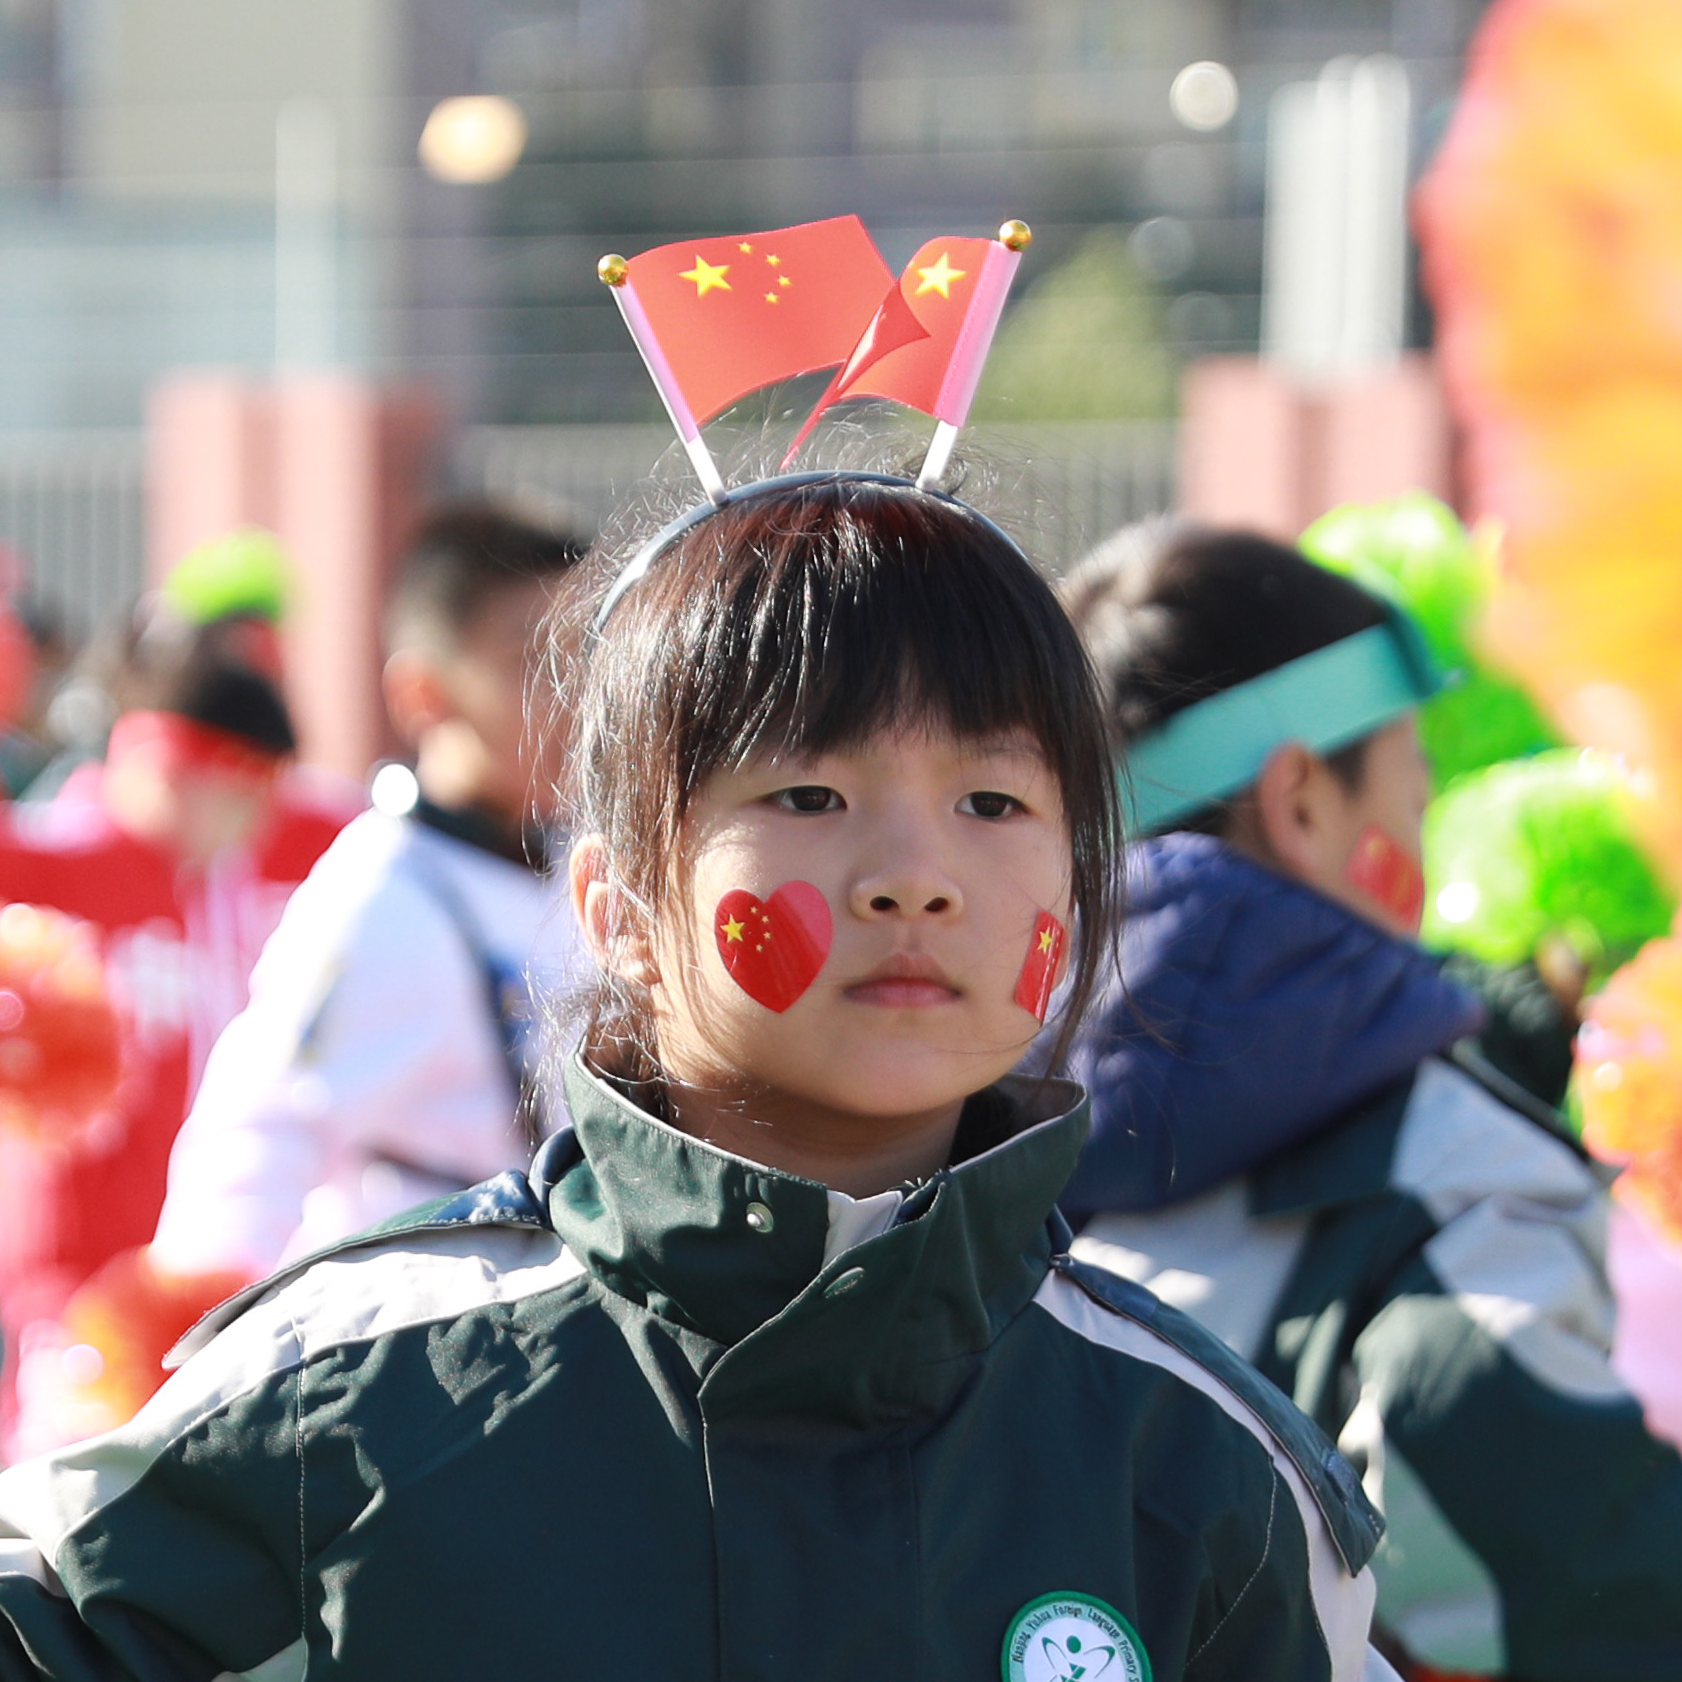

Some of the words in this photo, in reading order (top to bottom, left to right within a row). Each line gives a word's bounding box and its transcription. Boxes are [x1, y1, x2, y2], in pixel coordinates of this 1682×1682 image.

[1052, 1605, 1082, 1617] Foreign
[1087, 1608, 1120, 1639] Language
[1118, 1639, 1137, 1675] Primary
